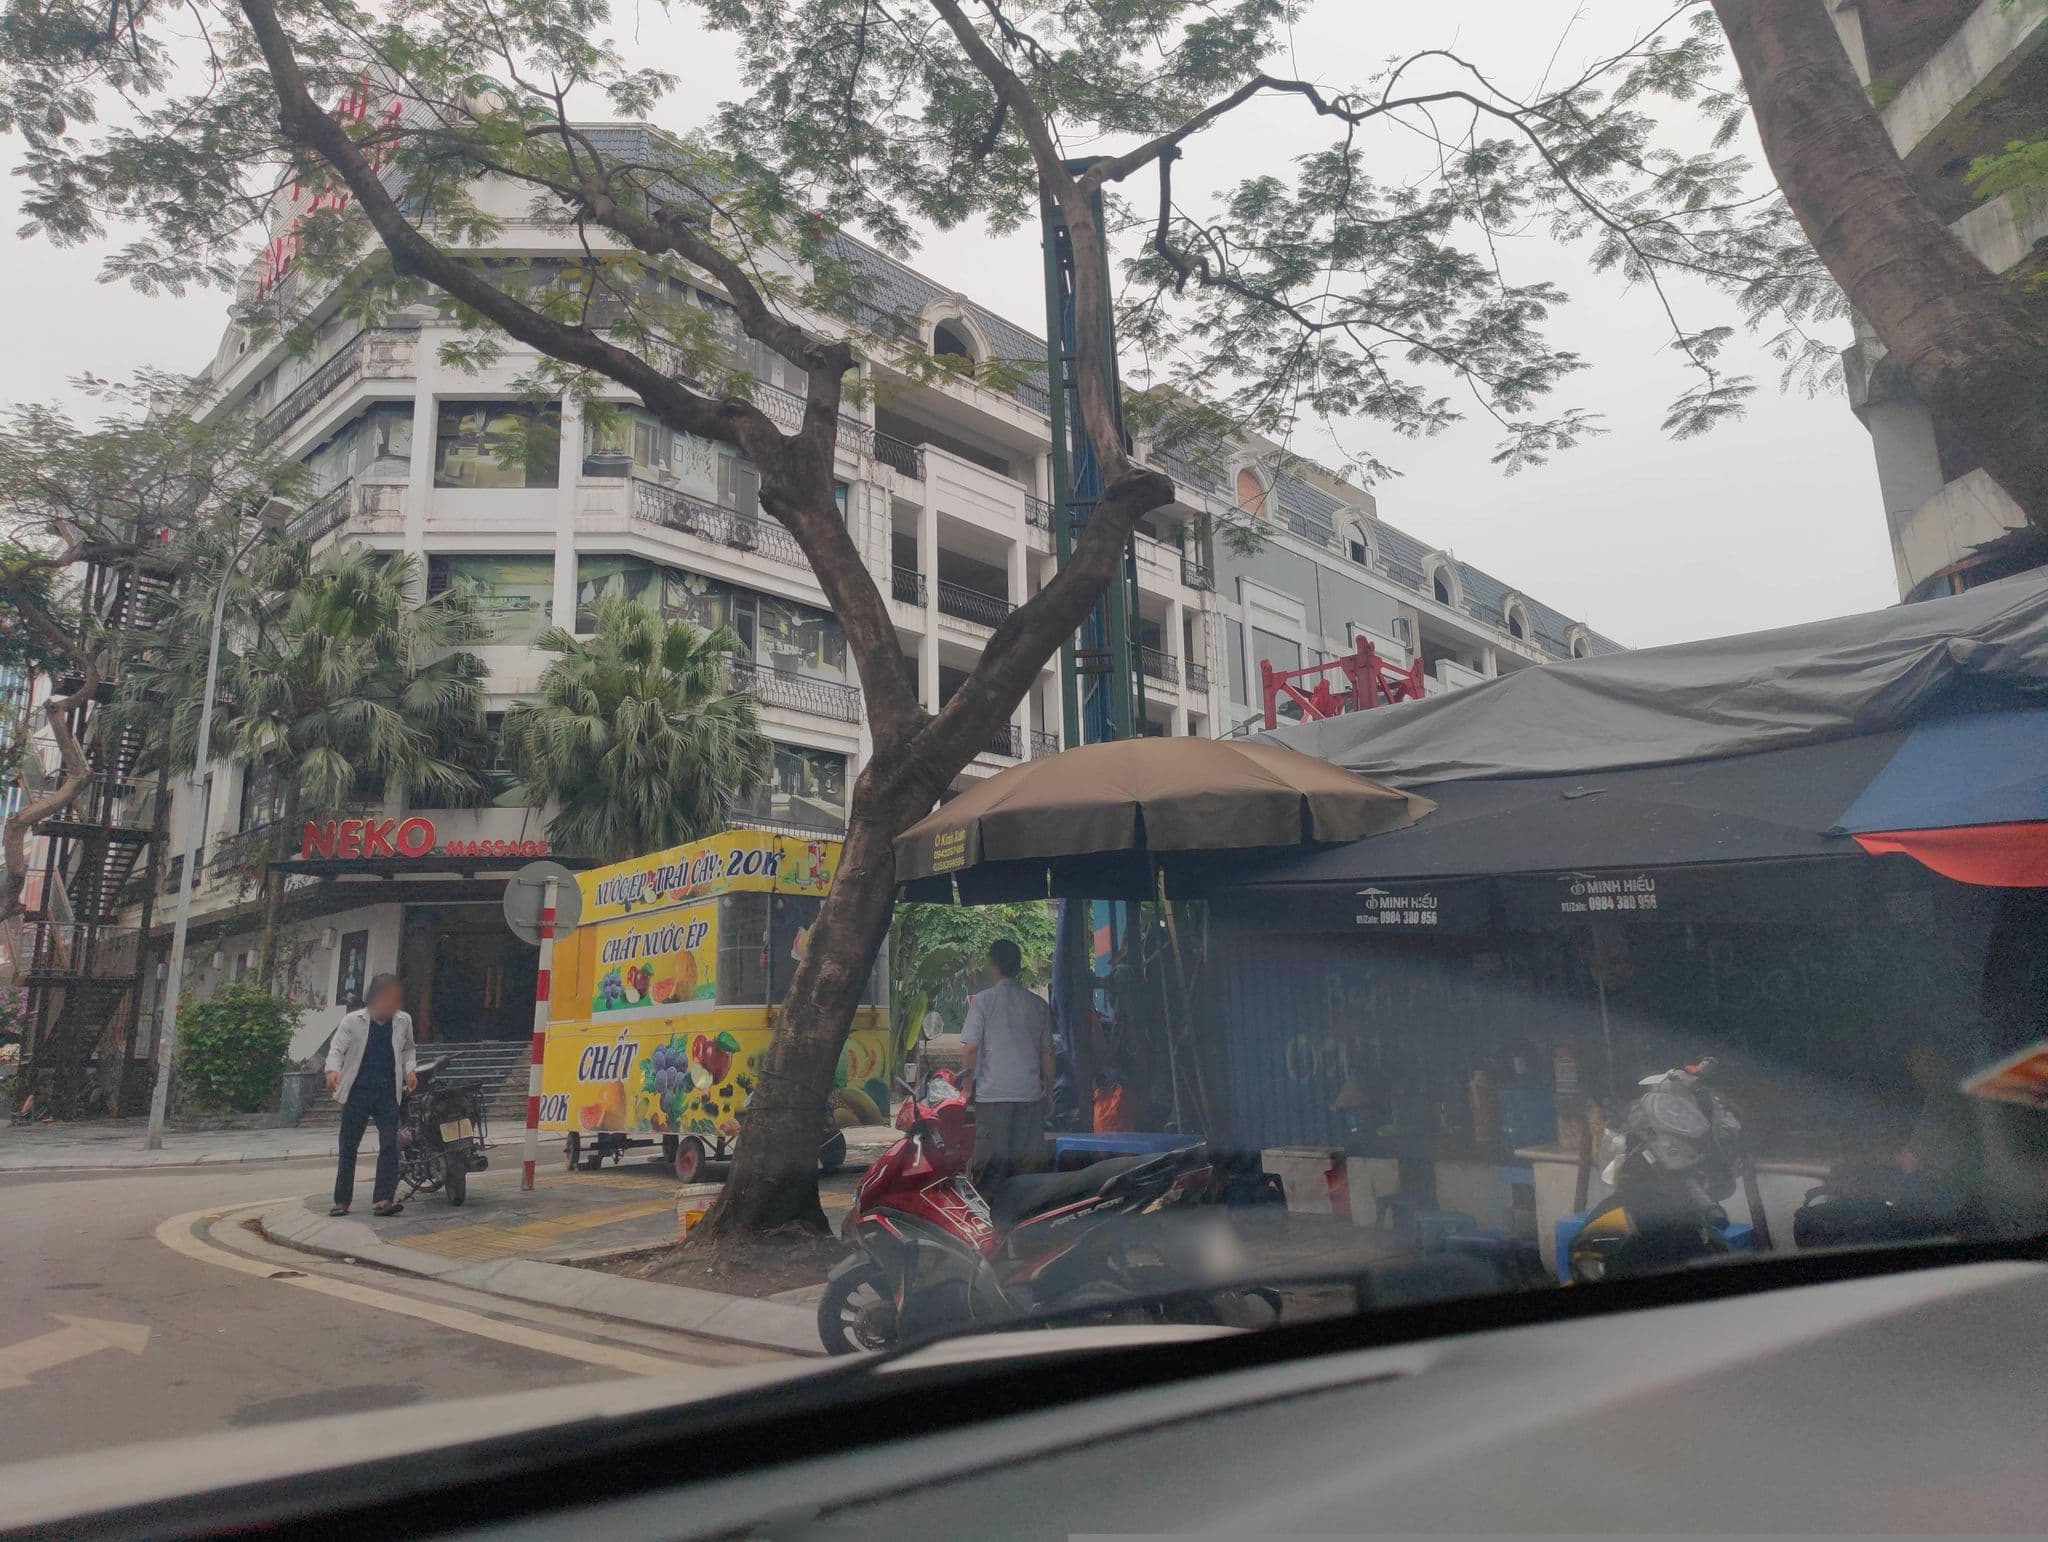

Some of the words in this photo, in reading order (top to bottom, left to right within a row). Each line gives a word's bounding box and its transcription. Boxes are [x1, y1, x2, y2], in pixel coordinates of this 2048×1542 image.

[301, 817, 436, 859] NEKO
[444, 839, 550, 857] MASSAGE
[656, 856, 689, 891] TRÁI
[726, 849, 780, 877] 20K
[1586, 880, 1621, 894] MINH
[1379, 897, 1409, 909] MINH
[1588, 895, 1615, 911] 0984
[1616, 894, 1637, 910] 380
[1380, 911, 1401, 924] 0984
[601, 926, 641, 963] CHẤT
[642, 922, 685, 957] NƯỚC
[685, 917, 708, 949] ÉP
[578, 1028, 638, 1081] CHẤT
